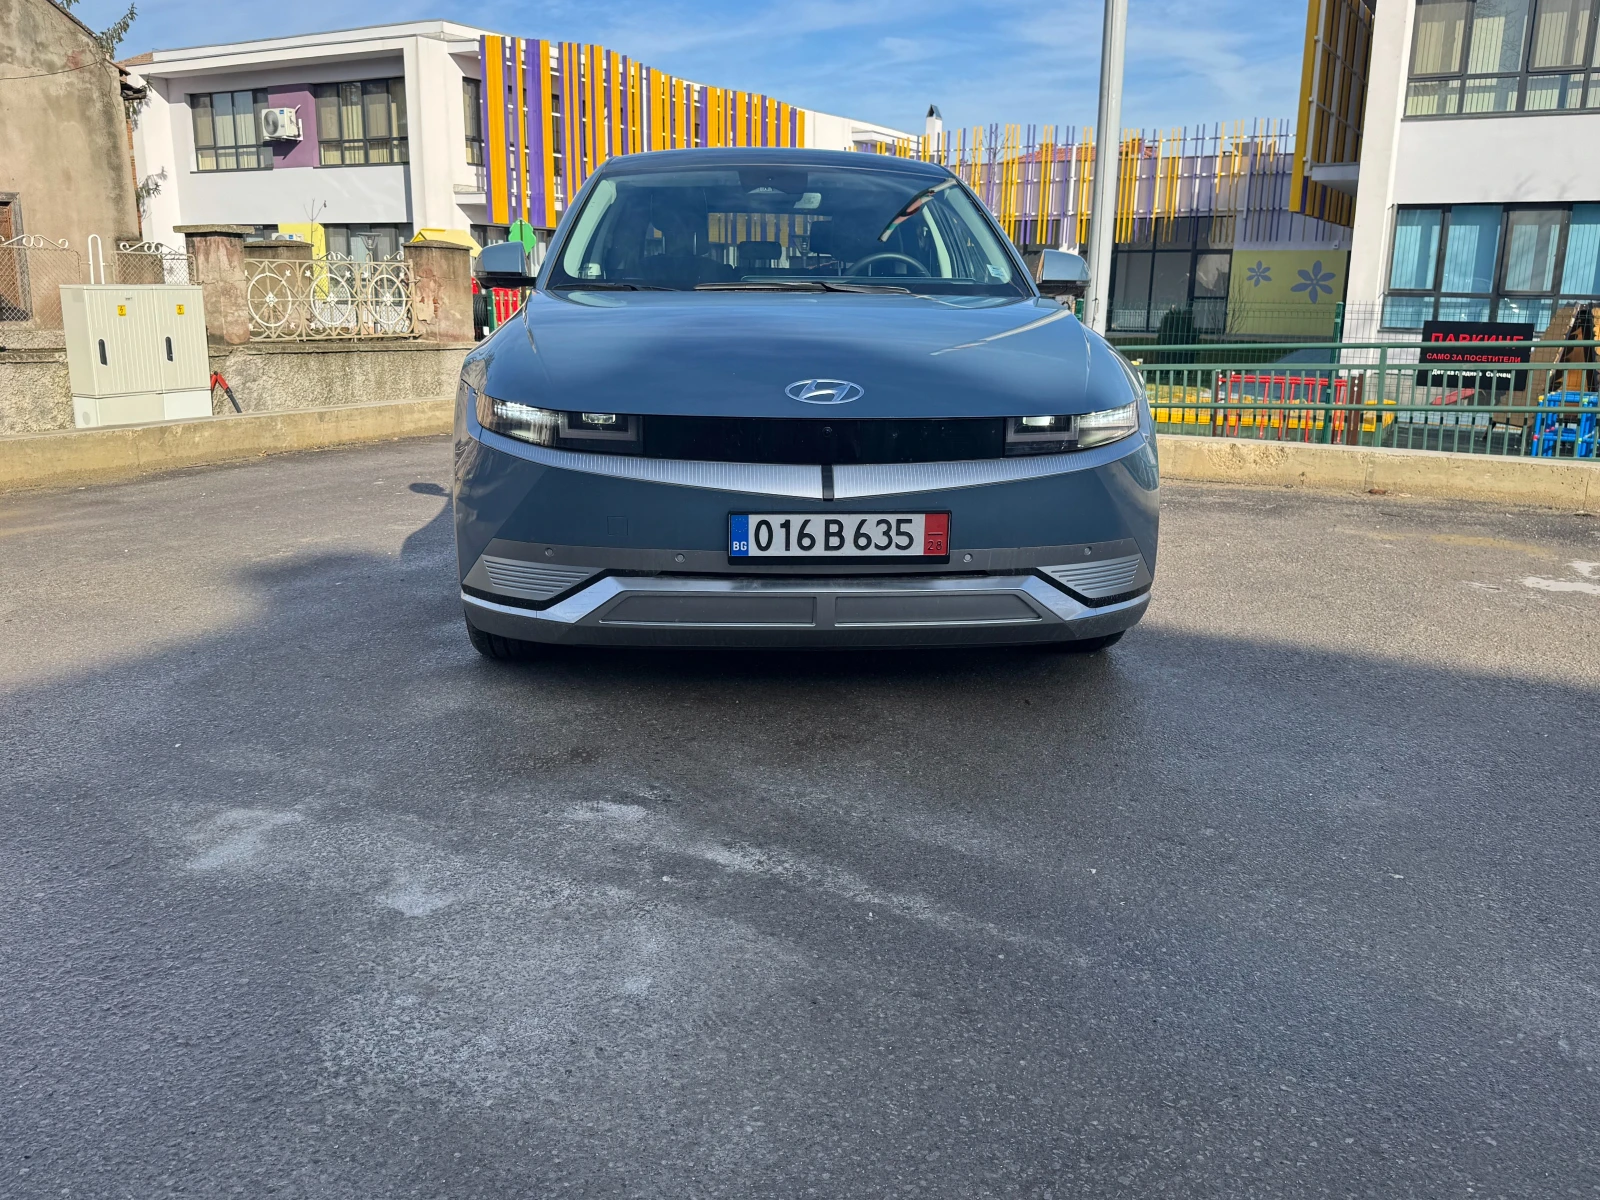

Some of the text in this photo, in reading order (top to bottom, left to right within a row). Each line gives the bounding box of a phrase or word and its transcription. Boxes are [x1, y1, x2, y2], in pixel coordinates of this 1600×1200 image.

[1426, 352, 1451, 361] САМО
[1463, 354, 1521, 364] ПОСЕТИТЕЛИ
[1431, 368, 1455, 376] Детка
[732, 541, 748, 551] BG
[927, 540, 943, 551] 28
